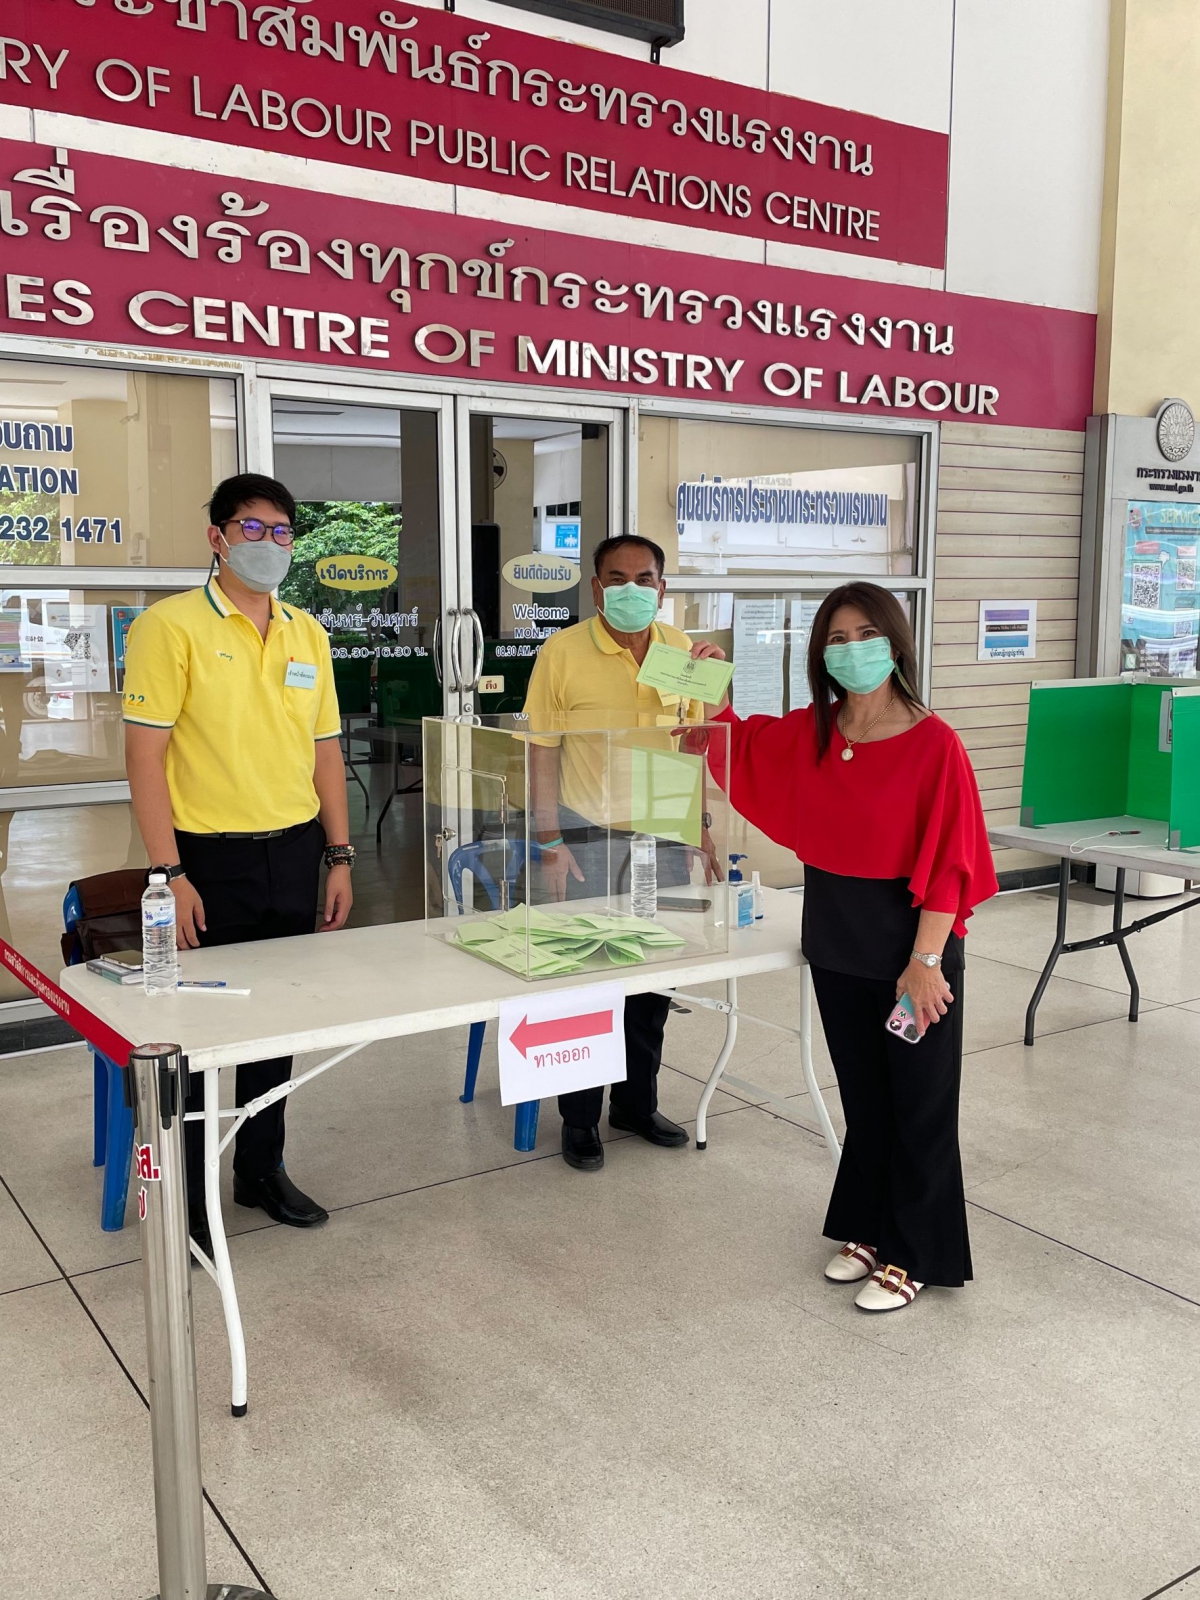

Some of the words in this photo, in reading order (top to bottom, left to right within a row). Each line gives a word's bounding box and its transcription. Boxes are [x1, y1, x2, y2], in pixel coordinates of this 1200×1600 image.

[0, 36, 70, 90] RY
[95, 58, 171, 108] OF
[193, 75, 391, 152] LABOUR
[409, 119, 550, 183] PUBLIC
[565, 151, 752, 219] RELATIONS
[766, 190, 881, 243] CENTRE
[6, 273, 95, 326] ES
[128, 289, 390, 359] CENTRE
[414, 323, 495, 368] OF
[517, 335, 745, 393] MINISTRY
[763, 361, 823, 400] OF
[838, 370, 1000, 417] LABOUR
[0, 420, 74, 453] บถาม
[0, 463, 79, 495] ATION
[1136, 467, 1200, 481] กระทรวงแรงงา
[677, 473, 888, 536] ศูนย์บริการประชาชนกระทรวงแรงงาน
[0, 515, 50, 542] 232
[61, 515, 122, 544] 1471
[320, 563, 389, 581] เปิดบริการ
[513, 564, 572, 582] ยินดีต้อนรับ
[512, 602, 570, 621] Welcome
[330, 646, 412, 659] 08.30-16.30
[414, 647, 429, 658] น.
[495, 645, 517, 658] 08.30
[485, 680, 498, 691] ดึง
[533, 1045, 591, 1069] ทางออก
